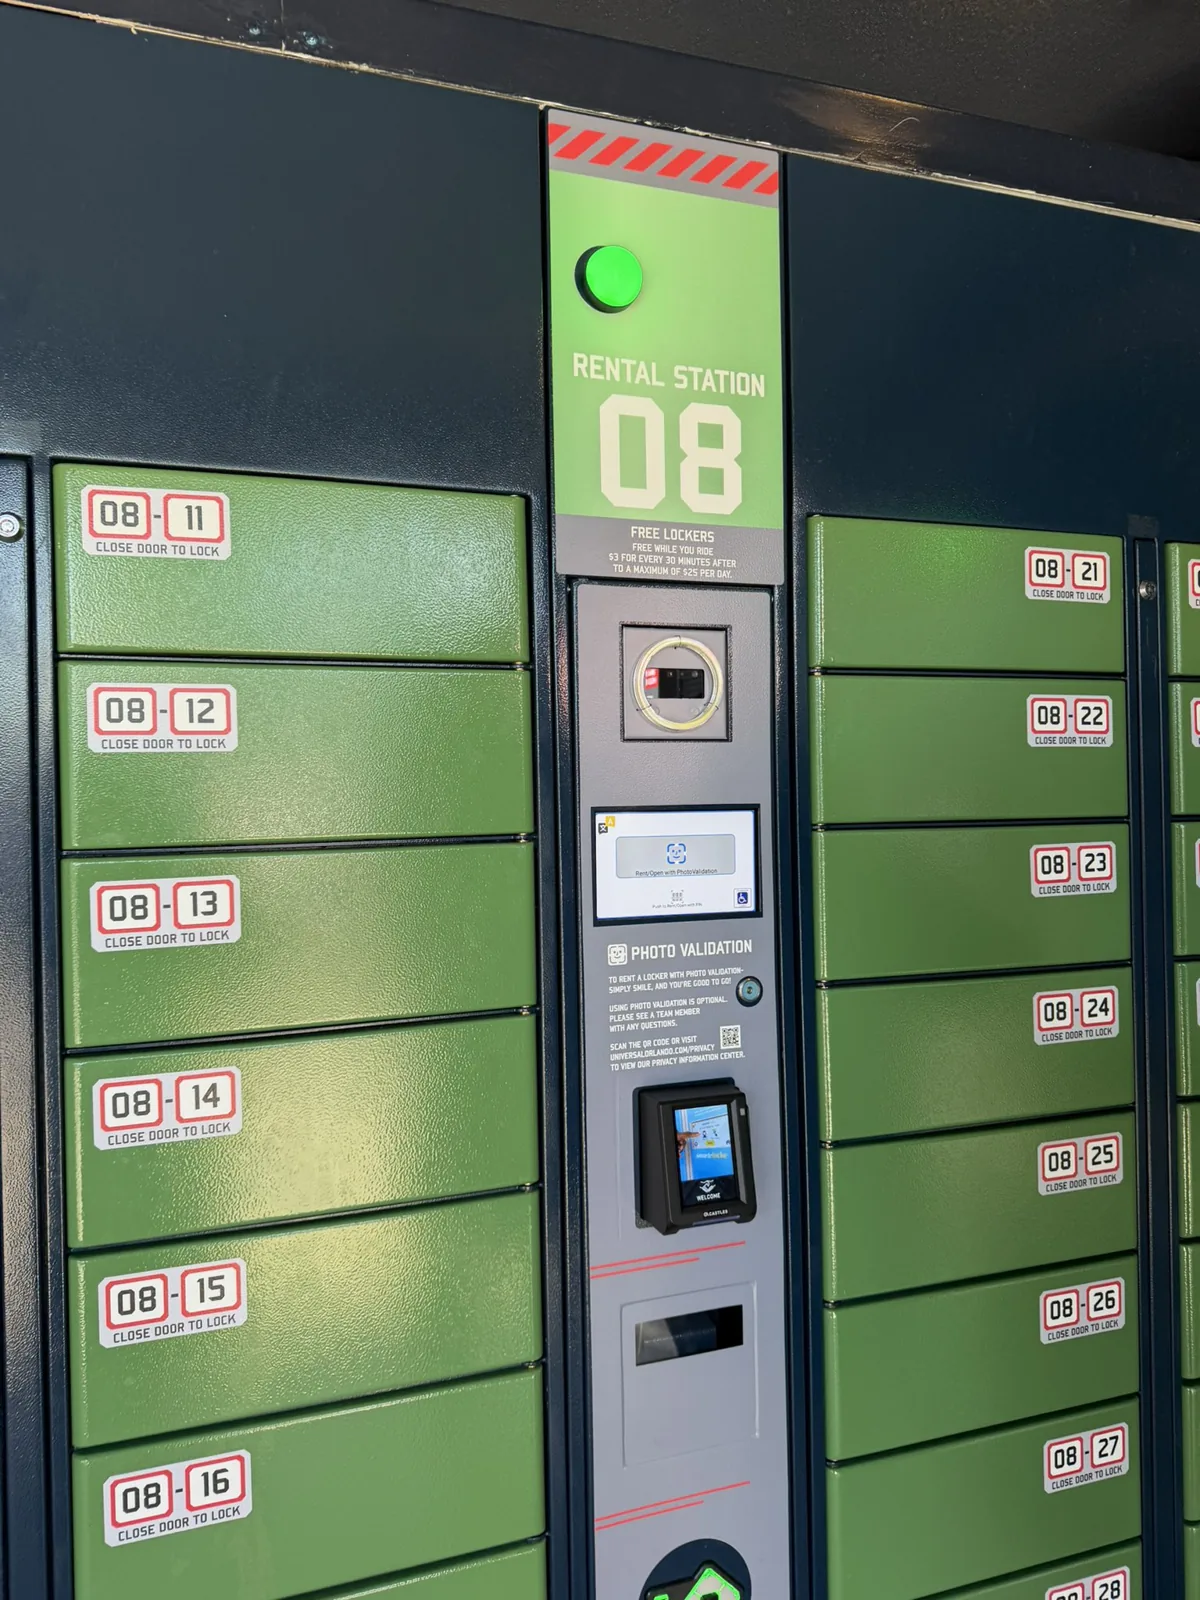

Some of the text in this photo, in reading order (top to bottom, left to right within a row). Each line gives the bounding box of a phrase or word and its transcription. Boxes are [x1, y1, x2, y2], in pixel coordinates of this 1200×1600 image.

[573, 352, 765, 398] RENTAL STATION
[600, 394, 742, 515] 08
[631, 526, 715, 543] FREE LOCKERS
[97, 542, 219, 556] CLOSE DOOR TO LOCK
[633, 543, 713, 556] FREE WHILE YOU RIDE
[609, 553, 736, 568] $3 FOR EVERY 30 MINUTES AFTER
[613, 564, 733, 579] TO A MAXIMUM OF $25 PER DAY.
[1033, 589, 1054, 598] CLOSE
[1056, 590, 1074, 599] DOOR
[1087, 592, 1104, 600] LOCK
[102, 739, 226, 749] CLOSE DOOR TO LOCK
[1035, 736, 1106, 745] CLOSE DOOR TO LOCK
[1039, 883, 1110, 895] CLOSE DOOR TO LOCK
[105, 930, 229, 948] CLOSE DOOR TO LOCK
[631, 939, 752, 960] PHOTO VALIDATION
[609, 976, 617, 984] TO
[619, 975, 635, 983] RENT
[643, 972, 668, 981] LOCKER
[670, 971, 684, 979] WITH
[686, 969, 706, 978] PHOTO
[609, 985, 631, 994] SIMPLY
[655, 982, 667, 990] AND
[669, 980, 691, 989] YOU'RE
[693, 979, 709, 987] GOOD
[711, 978, 720, 986] TO
[609, 1004, 629, 1012] USING
[630, 1002, 651, 1010] PHOTO
[653, 999, 687, 1009] VALIDATION
[689, 998, 695, 1006] IS
[609, 1014, 634, 1022] PLEASE
[636, 1012, 648, 1020] SEE
[656, 1010, 673, 1018] TEAM
[674, 1008, 700, 1017] MEMBER
[609, 1024, 625, 1032] WITH
[626, 1023, 639, 1031] ANY
[1042, 1028, 1113, 1042] CLOSE DOOR TO LOCK
[610, 1035, 697, 1051] SCAN THE QR CODE OR VISIT
[610, 1063, 619, 1071] TO
[620, 1062, 636, 1070] VIEW
[637, 1060, 650, 1068] OUR
[651, 1058, 677, 1067] PRIVACY
[678, 1054, 718, 1064] INFORMATION
[108, 1122, 230, 1145] CLOSE DOOR TO LOCK
[1046, 1174, 1117, 1193] CLOSE DOOR TO LOCK
[696, 1192, 721, 1202] WELCOME
[113, 1314, 236, 1343] CLOSE DOOR TO LOCK
[1048, 1319, 1119, 1341] CLOSE DOOR TO LOCK
[1052, 1465, 1123, 1490] CLOSE DOOR TO LOCK
[118, 1506, 240, 1541] CLOSE DOOR TO LOCK
